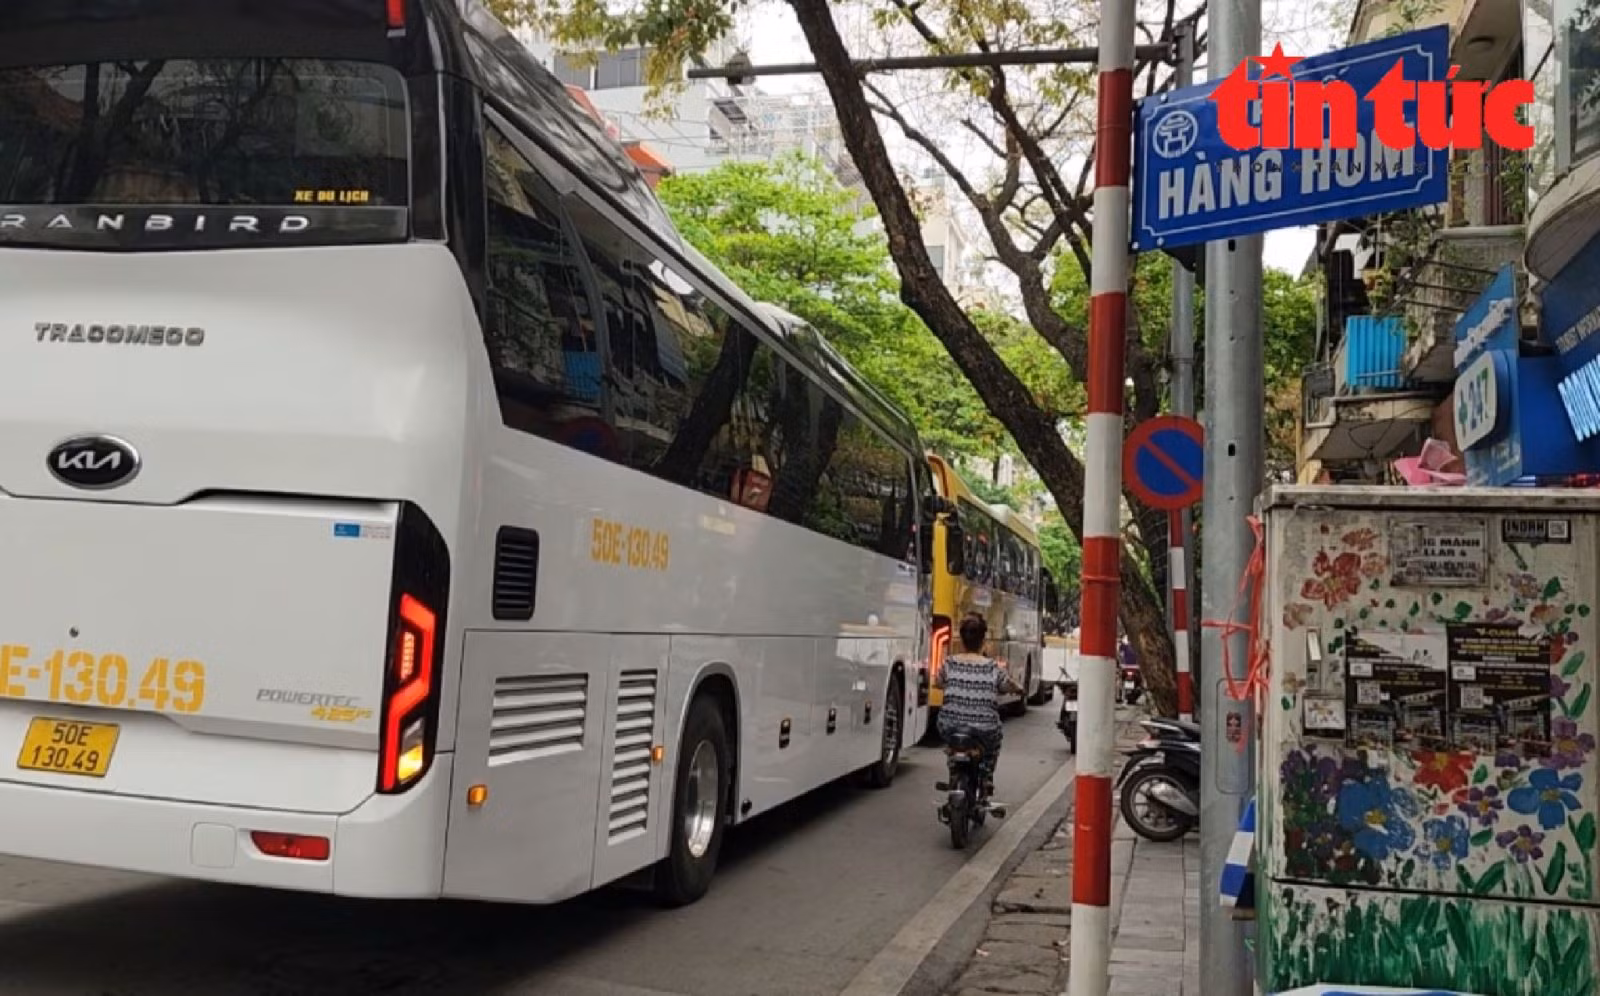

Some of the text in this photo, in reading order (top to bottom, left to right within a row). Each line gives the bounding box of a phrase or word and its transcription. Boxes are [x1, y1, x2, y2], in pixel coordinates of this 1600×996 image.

[294, 190, 314, 202] XE
[1158, 150, 1284, 220] HÀNG
[58, 450, 121, 470] KIA
[592, 517, 670, 571] 50E-130.49
[0, 644, 205, 712] E-130.49
[52, 723, 92, 746] 50E
[32, 746, 100, 772] 130.49
